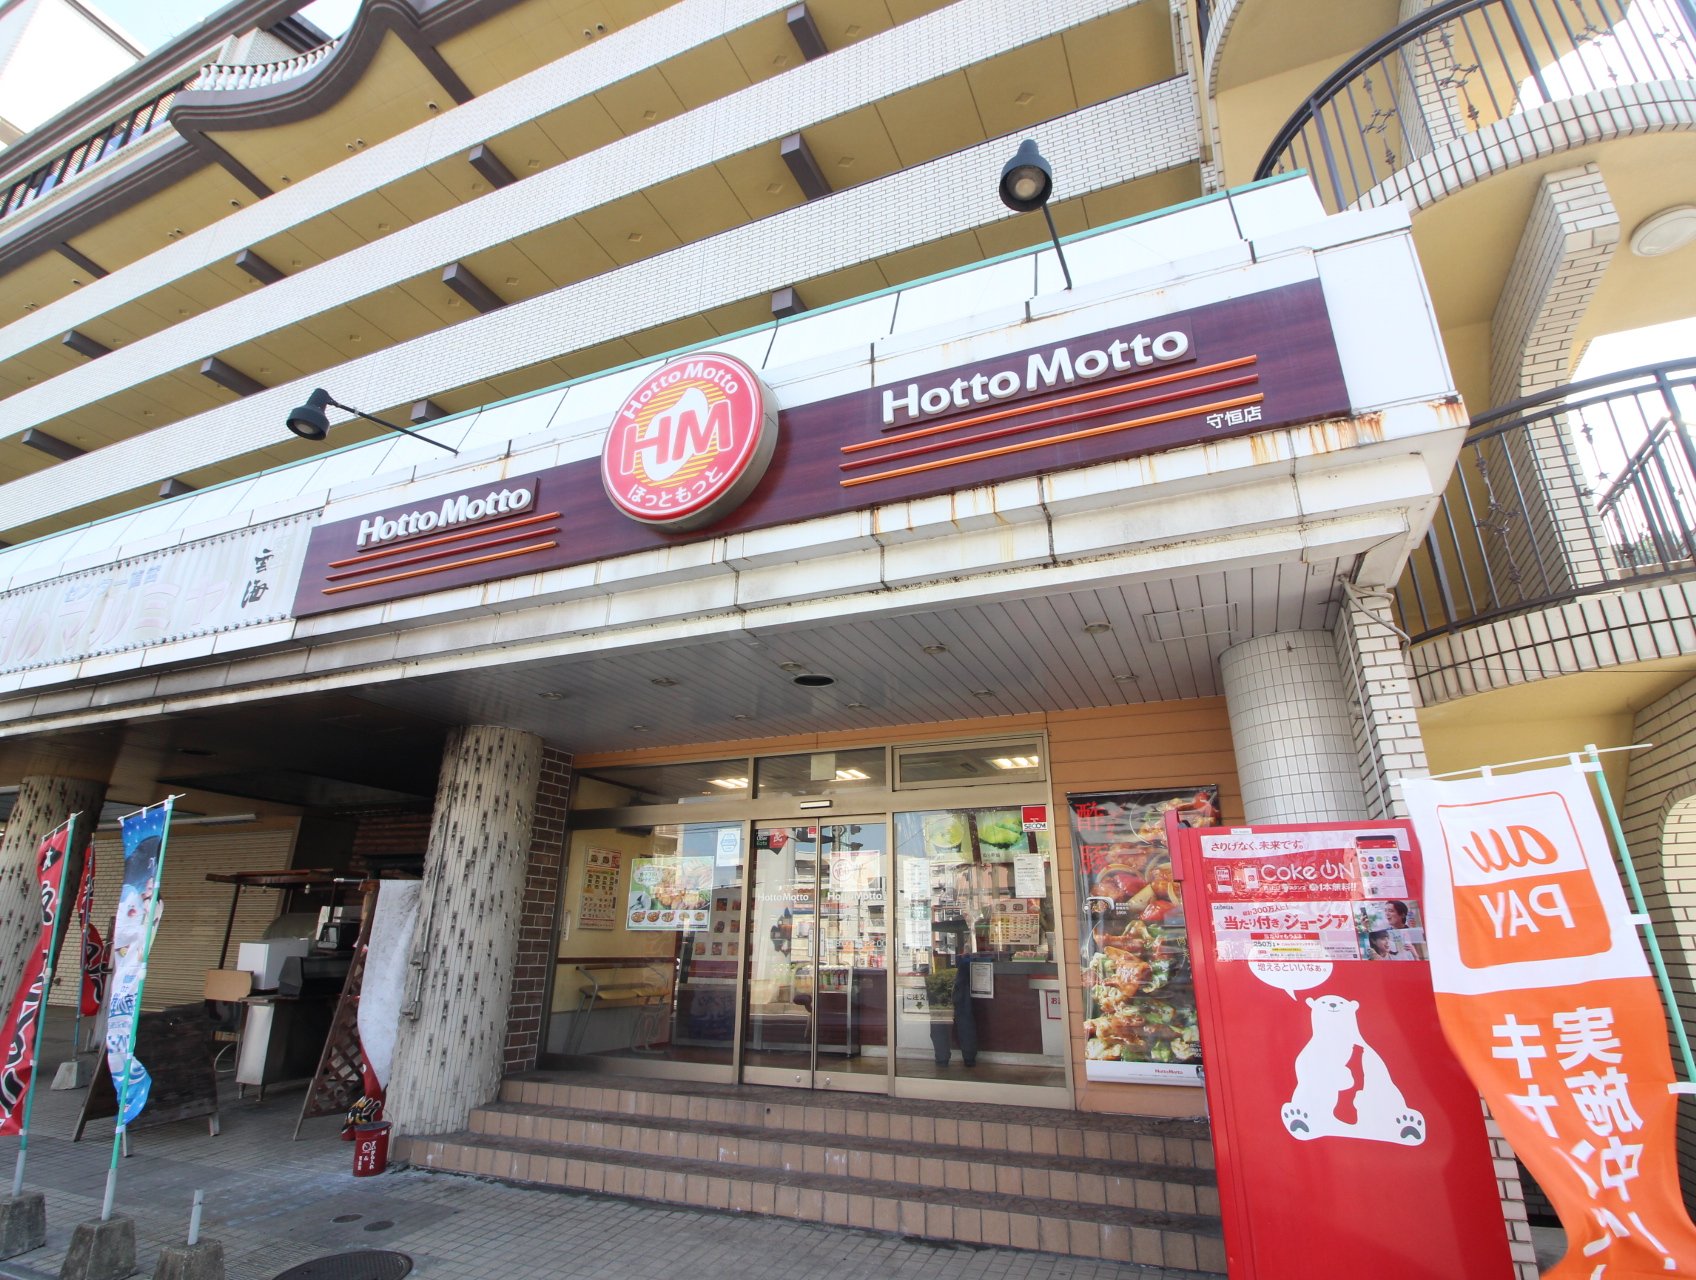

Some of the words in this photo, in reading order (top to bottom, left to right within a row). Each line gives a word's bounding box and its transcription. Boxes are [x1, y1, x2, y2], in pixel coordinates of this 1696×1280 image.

[1205, 405, 1263, 430] 守恒店
[619, 399, 734, 476] HM
[628, 466, 724, 508] ほっともっと
[1023, 822, 1047, 830] SECOM
[1260, 863, 1317, 881] Coke
[1320, 859, 1355, 881] ON
